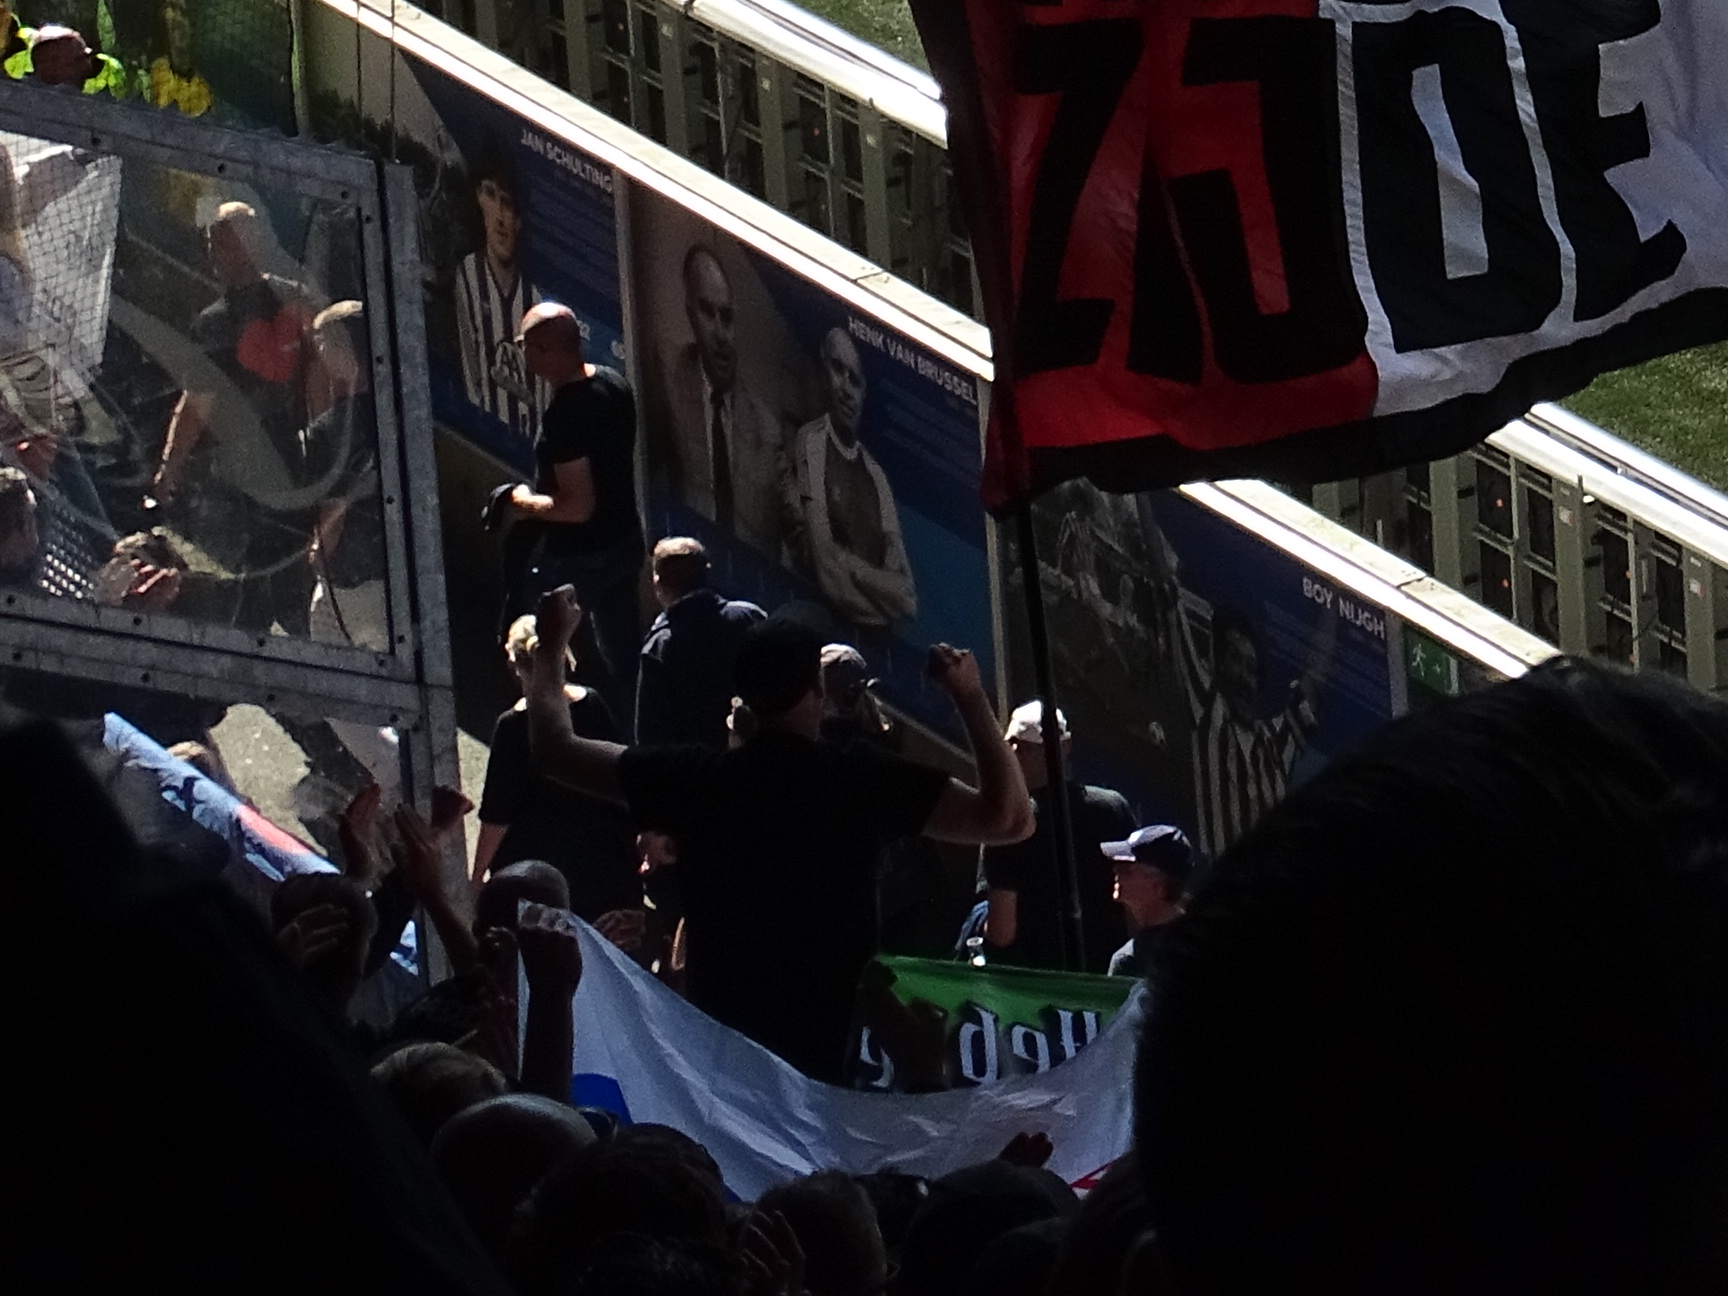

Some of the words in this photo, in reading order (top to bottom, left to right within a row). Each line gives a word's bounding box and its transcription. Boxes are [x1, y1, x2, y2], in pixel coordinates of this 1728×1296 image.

[521, 128, 546, 156] JAN
[545, 141, 613, 194] SCHULTING
[847, 314, 885, 353] HENK
[886, 337, 916, 369] VAN
[917, 355, 978, 406] BRUSSEL
[1338, 594, 1386, 641] NIJGH
